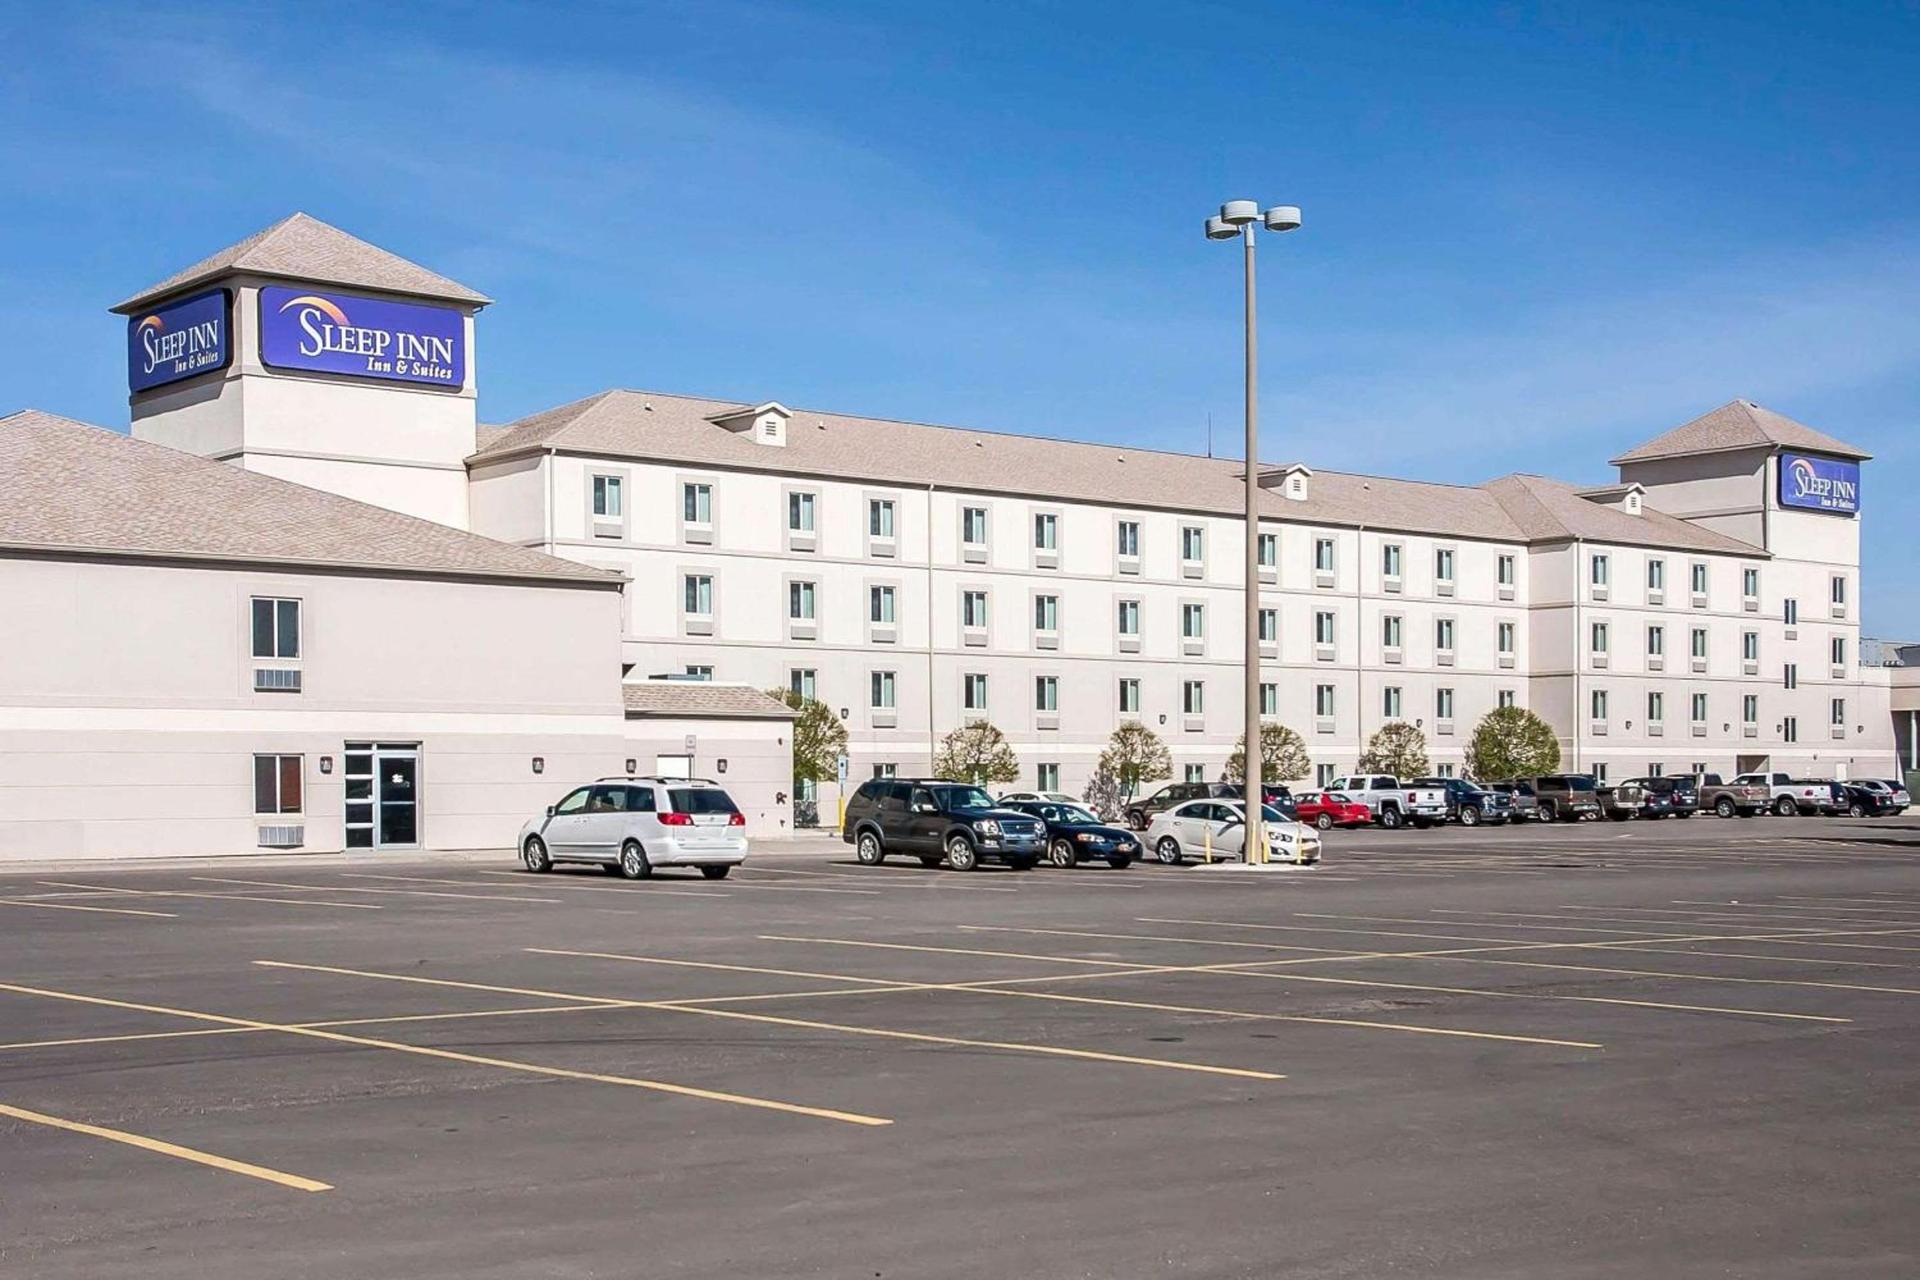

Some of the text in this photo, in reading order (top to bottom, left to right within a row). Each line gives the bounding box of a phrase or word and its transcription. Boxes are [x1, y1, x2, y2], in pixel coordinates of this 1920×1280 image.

[143, 319, 218, 374] SLEEP INN
[299, 308, 454, 364] SLEEP INN
[174, 351, 219, 374] Inn & Suites
[367, 356, 453, 379] Inn & Suites
[1795, 466, 1856, 500] SLEEP INN
